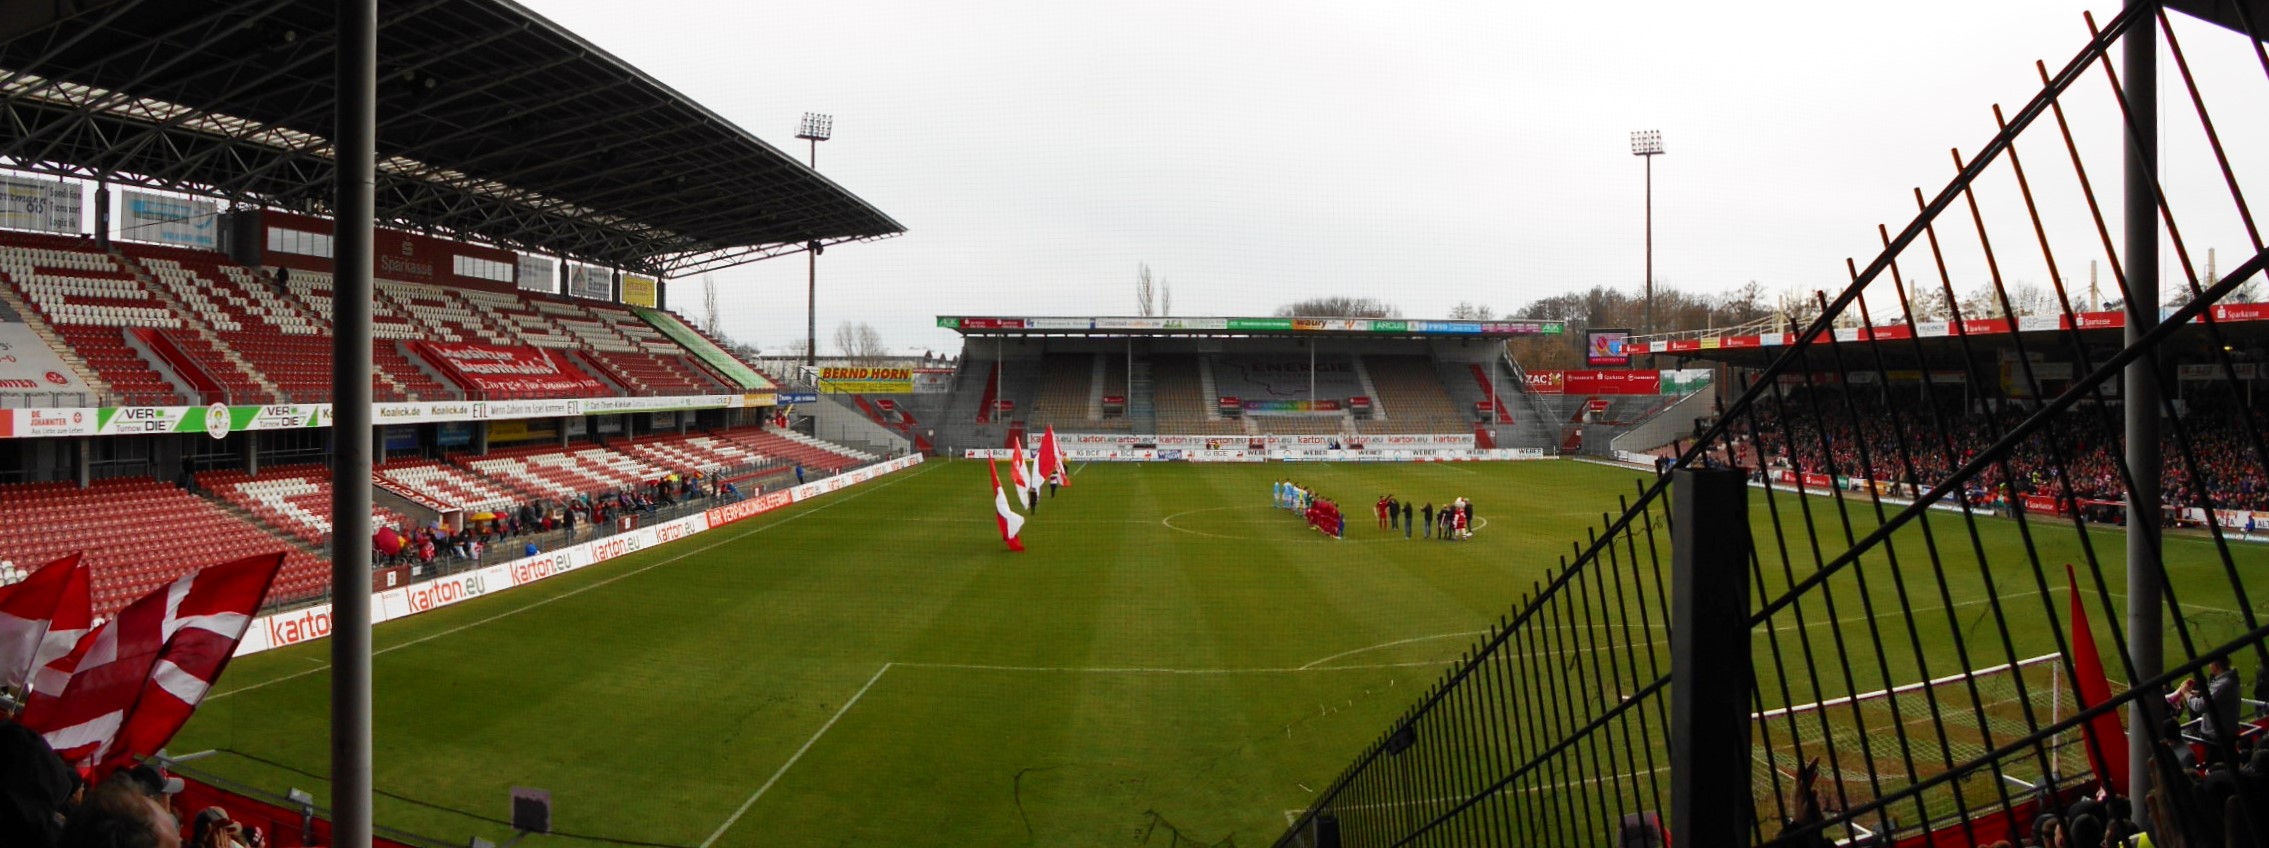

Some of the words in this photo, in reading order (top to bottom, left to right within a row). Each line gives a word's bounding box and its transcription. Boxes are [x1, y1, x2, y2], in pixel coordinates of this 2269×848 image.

[381, 254, 434, 278] Sparkasse
[2227, 309, 2259, 319] Sparkasse
[2020, 317, 2039, 329] HSP
[822, 367, 868, 379] BERND
[870, 368, 909, 380] HORN
[1525, 374, 1547, 384] ZAC
[125, 408, 154, 419] VER
[267, 406, 290, 416] VER
[473, 403, 488, 418] ETL
[567, 400, 580, 415] ETL
[145, 420, 166, 431] DIE
[282, 417, 300, 427] DIE
[1388, 435, 1428, 444] karton.eu
[709, 512, 722, 527] IHR
[655, 520, 696, 544] karton.eu
[590, 535, 641, 563] karton.eu
[510, 552, 572, 586] karton.eu
[406, 575, 486, 614] karton.eu
[269, 610, 332, 647] karto
